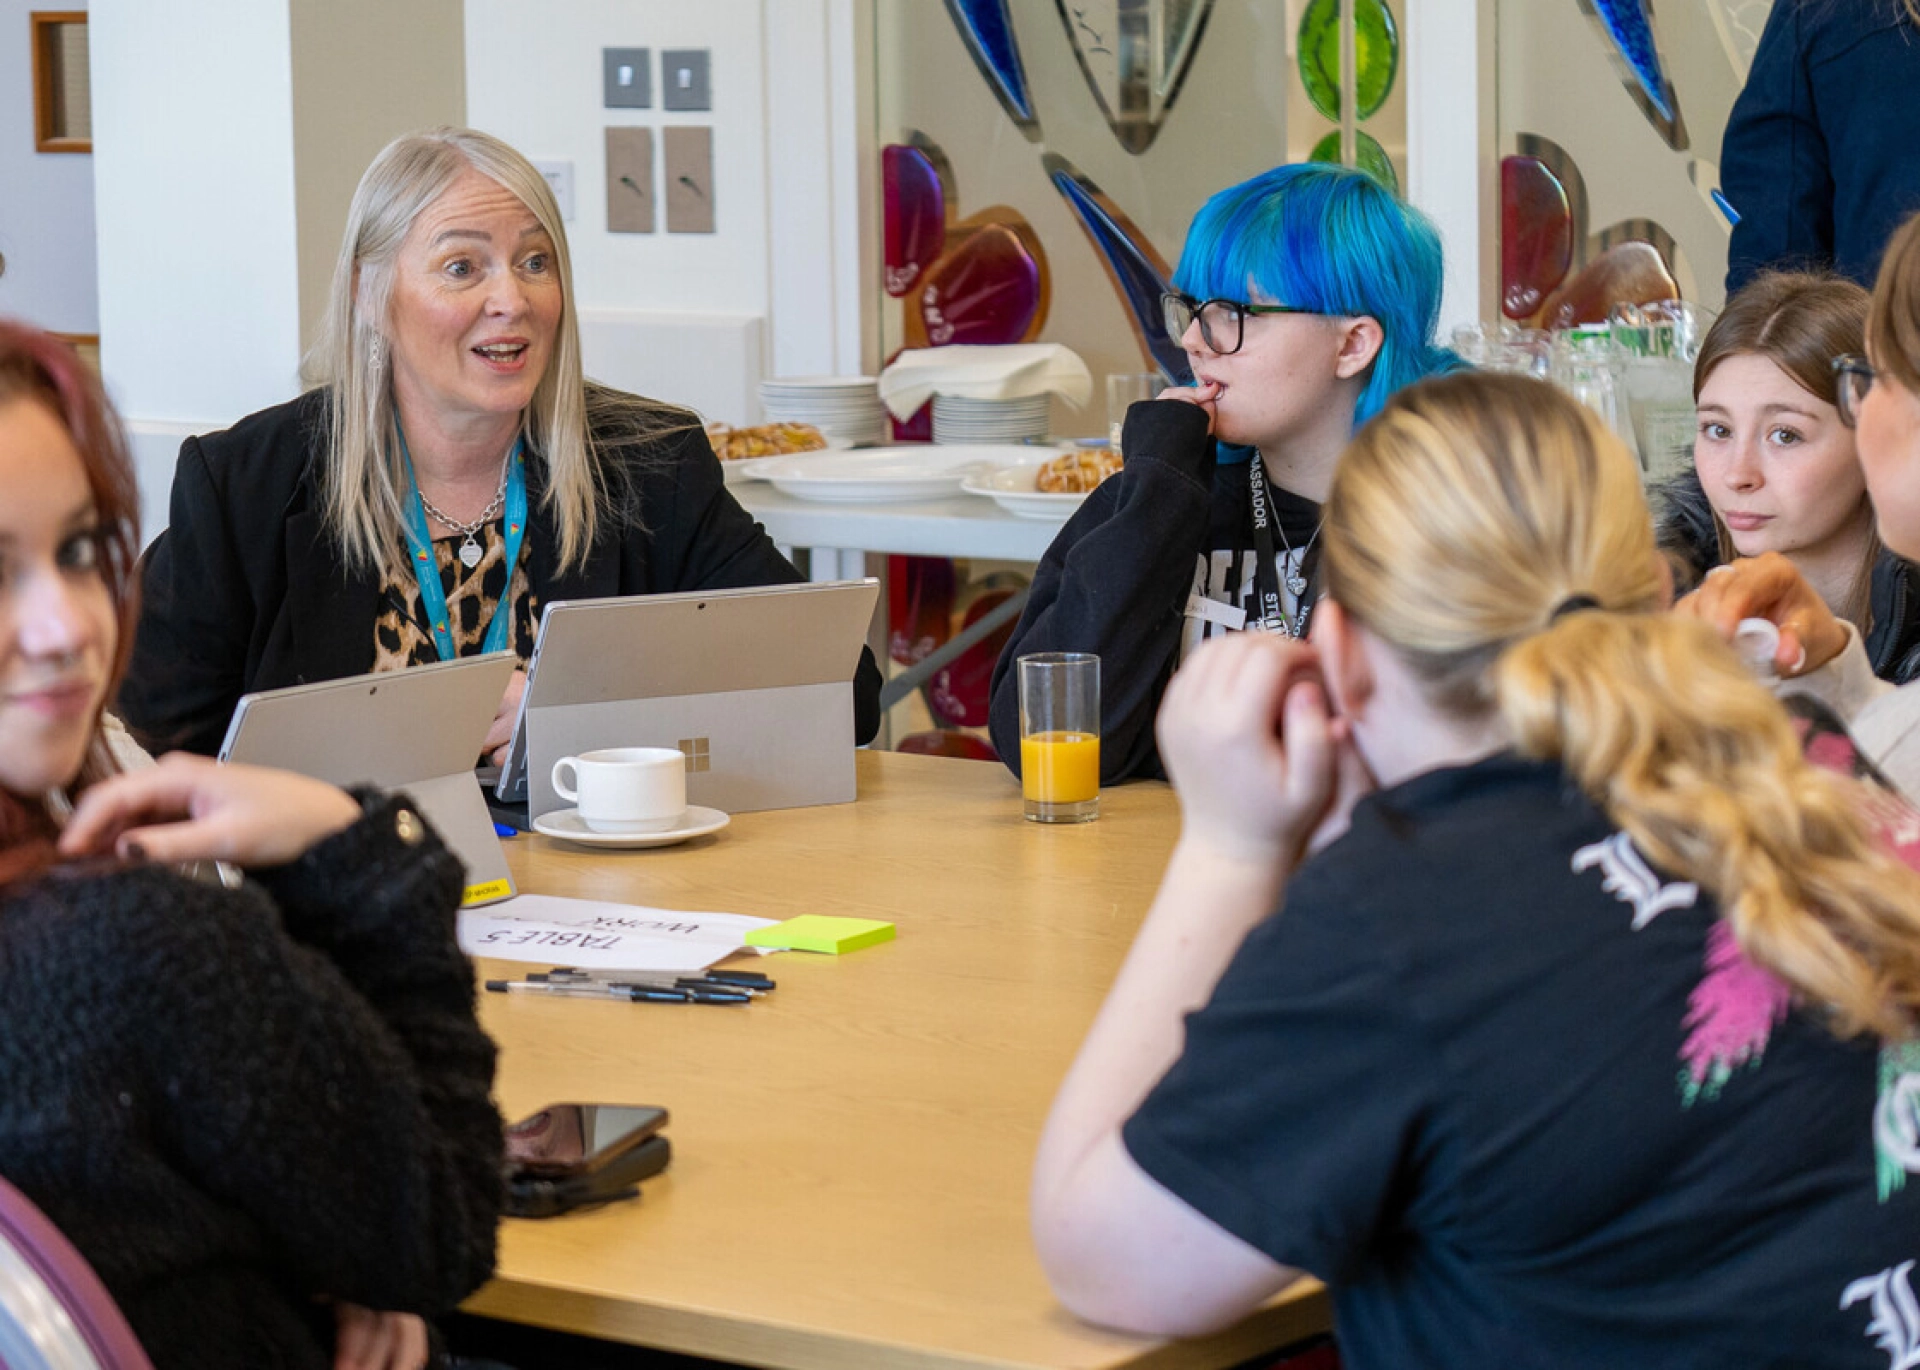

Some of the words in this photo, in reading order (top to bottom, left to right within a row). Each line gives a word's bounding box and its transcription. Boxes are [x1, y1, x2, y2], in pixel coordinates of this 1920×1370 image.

[1249, 447, 1268, 529] BASSADOR
[477, 930, 512, 944] 5
[507, 930, 623, 950] TABLE
